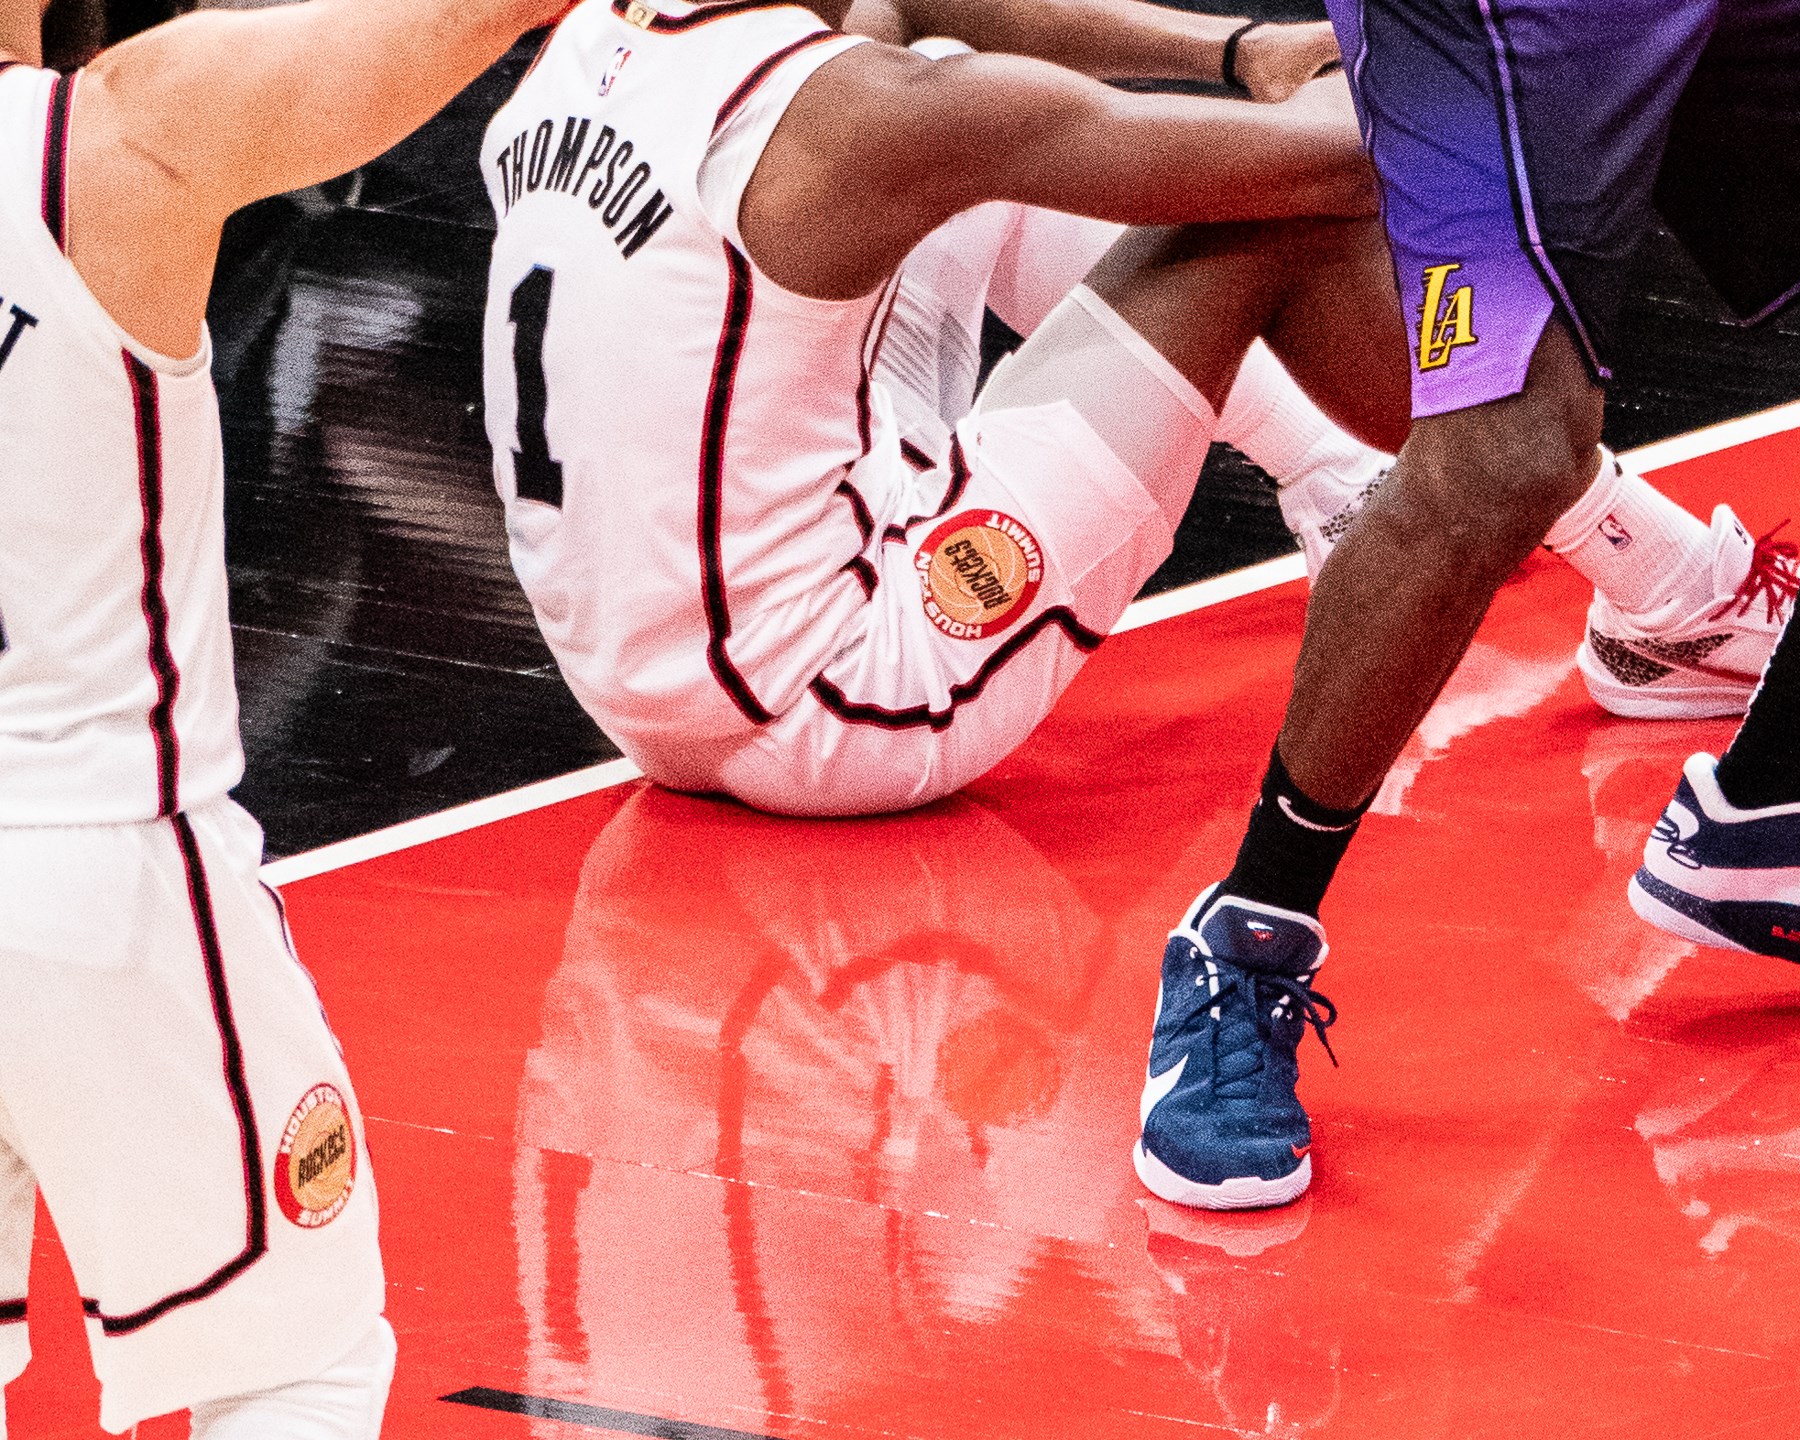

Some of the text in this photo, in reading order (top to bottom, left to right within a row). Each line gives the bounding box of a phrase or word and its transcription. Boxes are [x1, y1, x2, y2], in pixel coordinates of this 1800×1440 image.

[497, 116, 674, 260] THOMPSON
[1415, 263, 1478, 372] LA
[508, 263, 563, 509] 1
[985, 513, 1041, 583] SUMMIT
